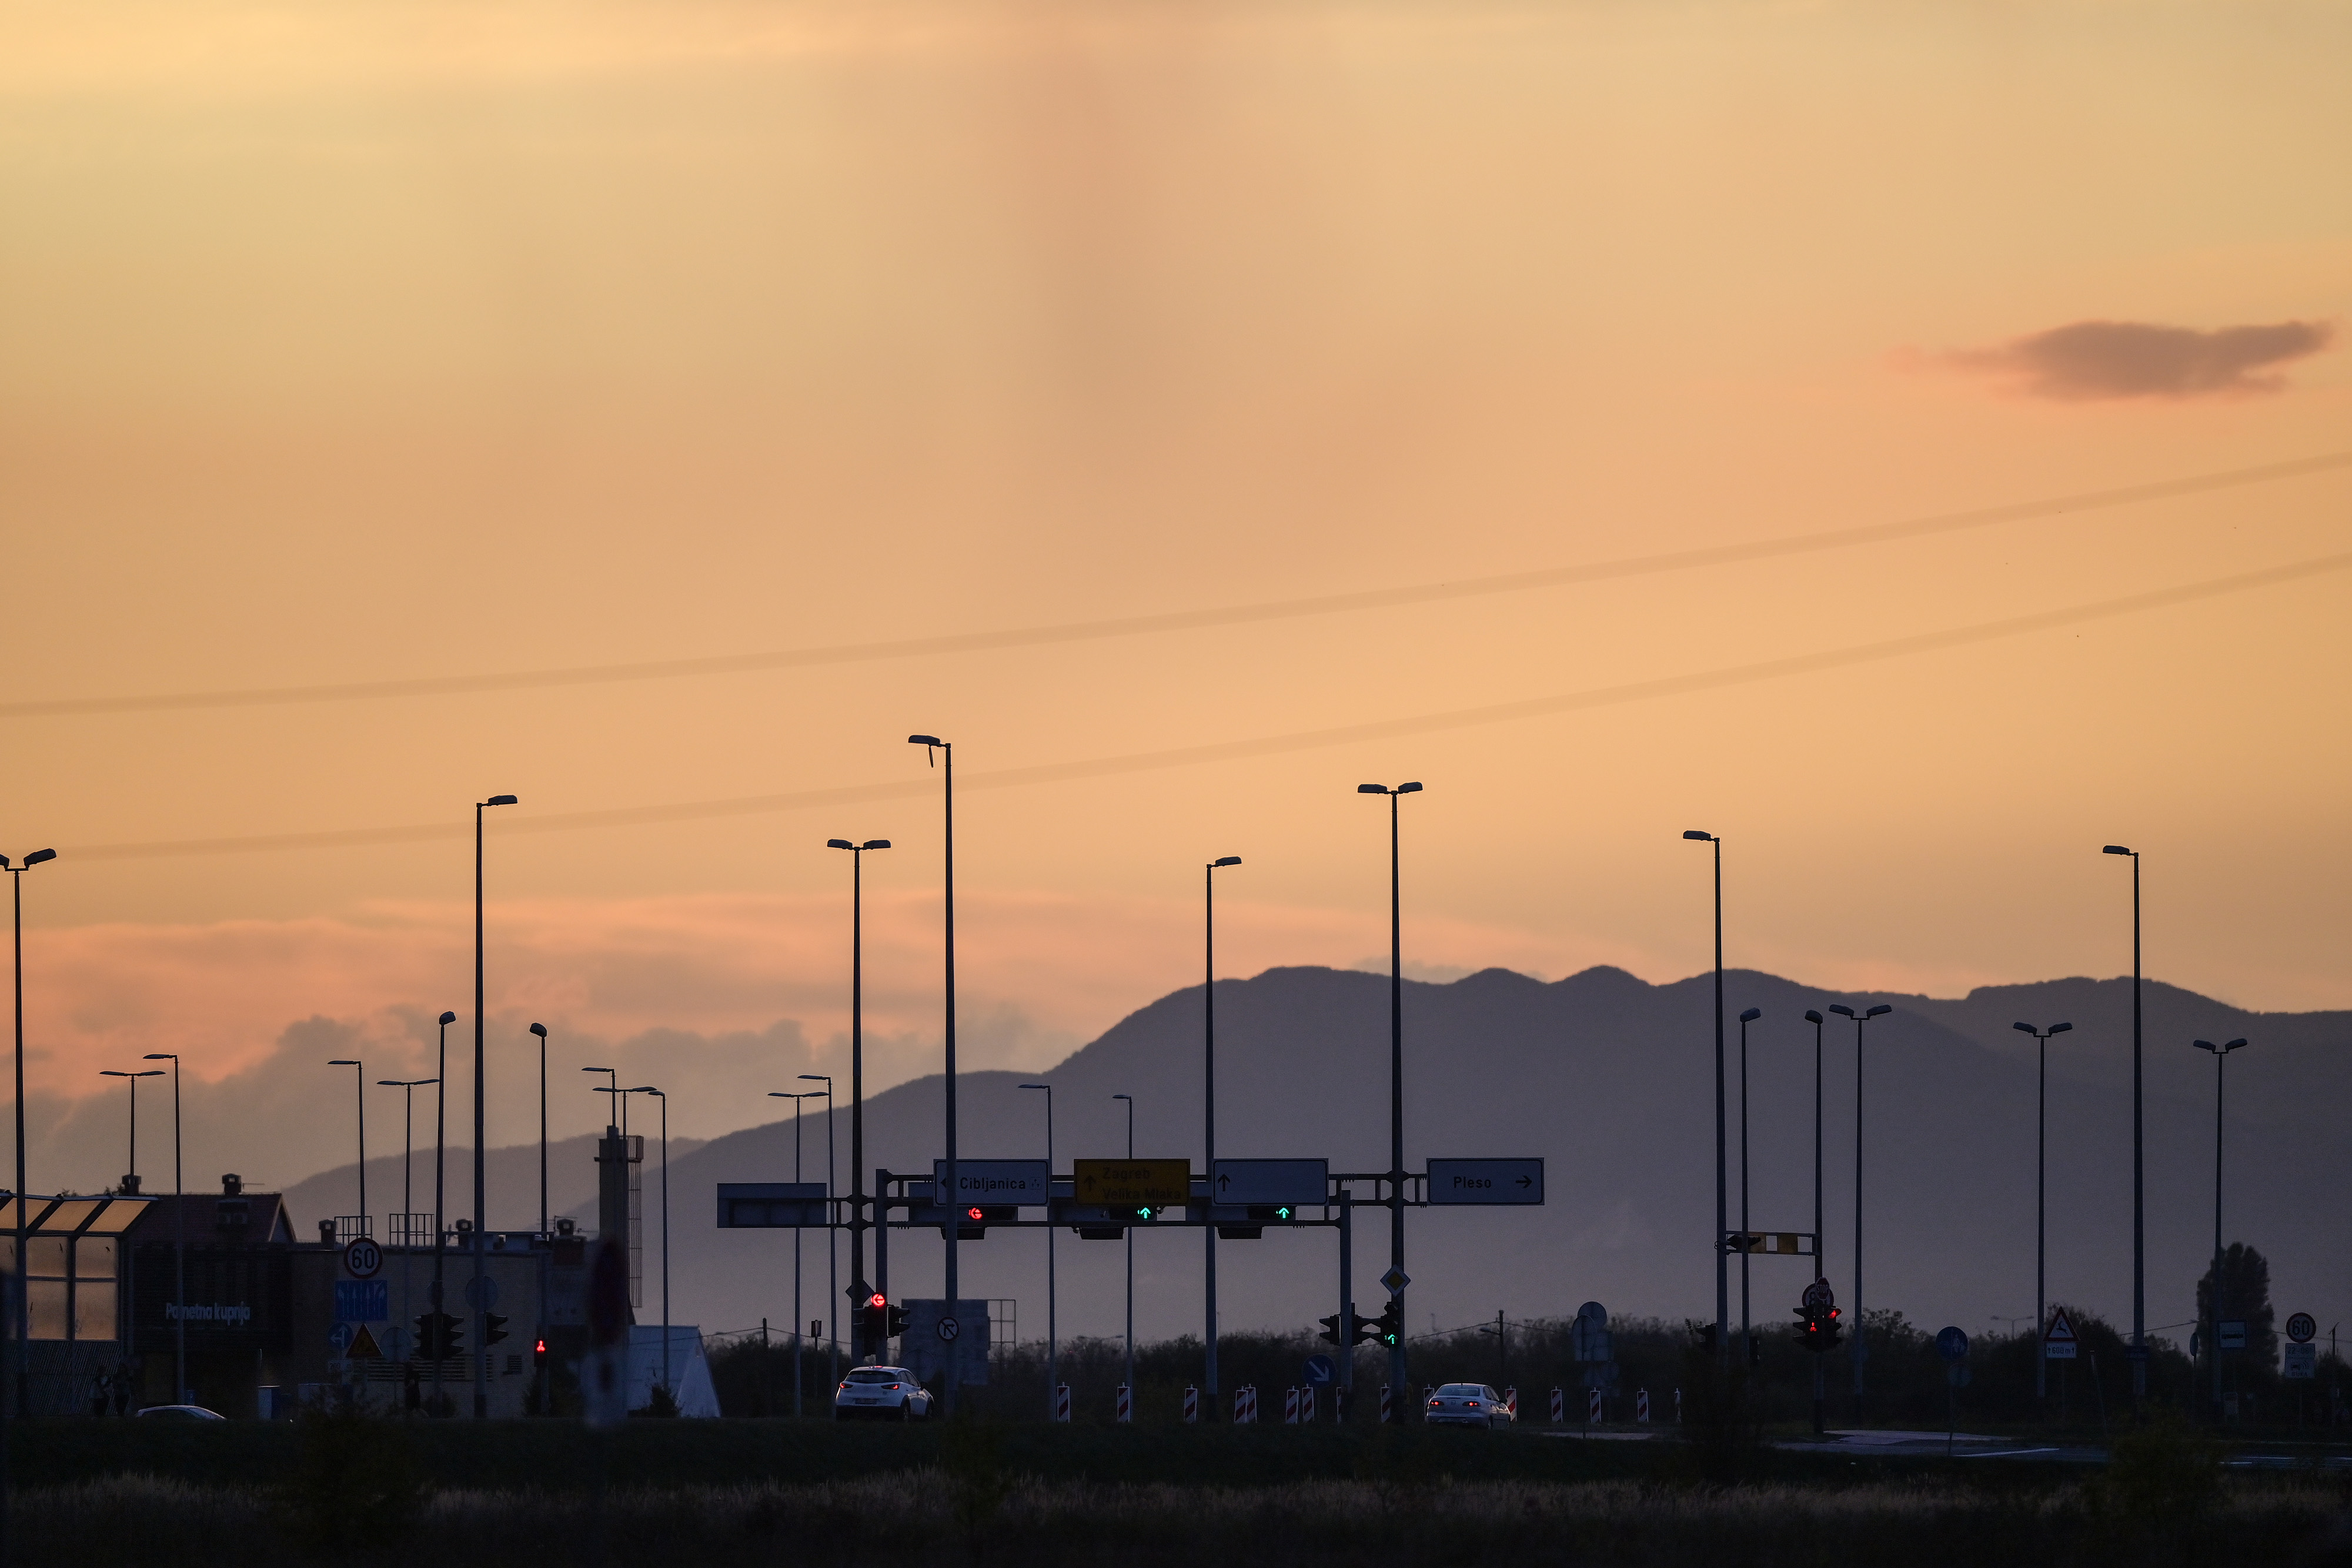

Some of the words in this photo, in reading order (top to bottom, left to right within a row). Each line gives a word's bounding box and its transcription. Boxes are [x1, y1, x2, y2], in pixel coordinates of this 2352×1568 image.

[1102, 1167, 1150, 1182] Zagreb
[1454, 1176, 1492, 1188] Pleso
[960, 1177, 1026, 1192] Cibljanica
[1102, 1188, 1140, 1199] Velika
[1145, 1188, 1181, 1199] Mlaka
[352, 1248, 375, 1269] 60
[1816, 1284, 1829, 1293] STOP
[214, 1300, 250, 1326] kupnja
[2292, 1320, 2310, 1335] 60
